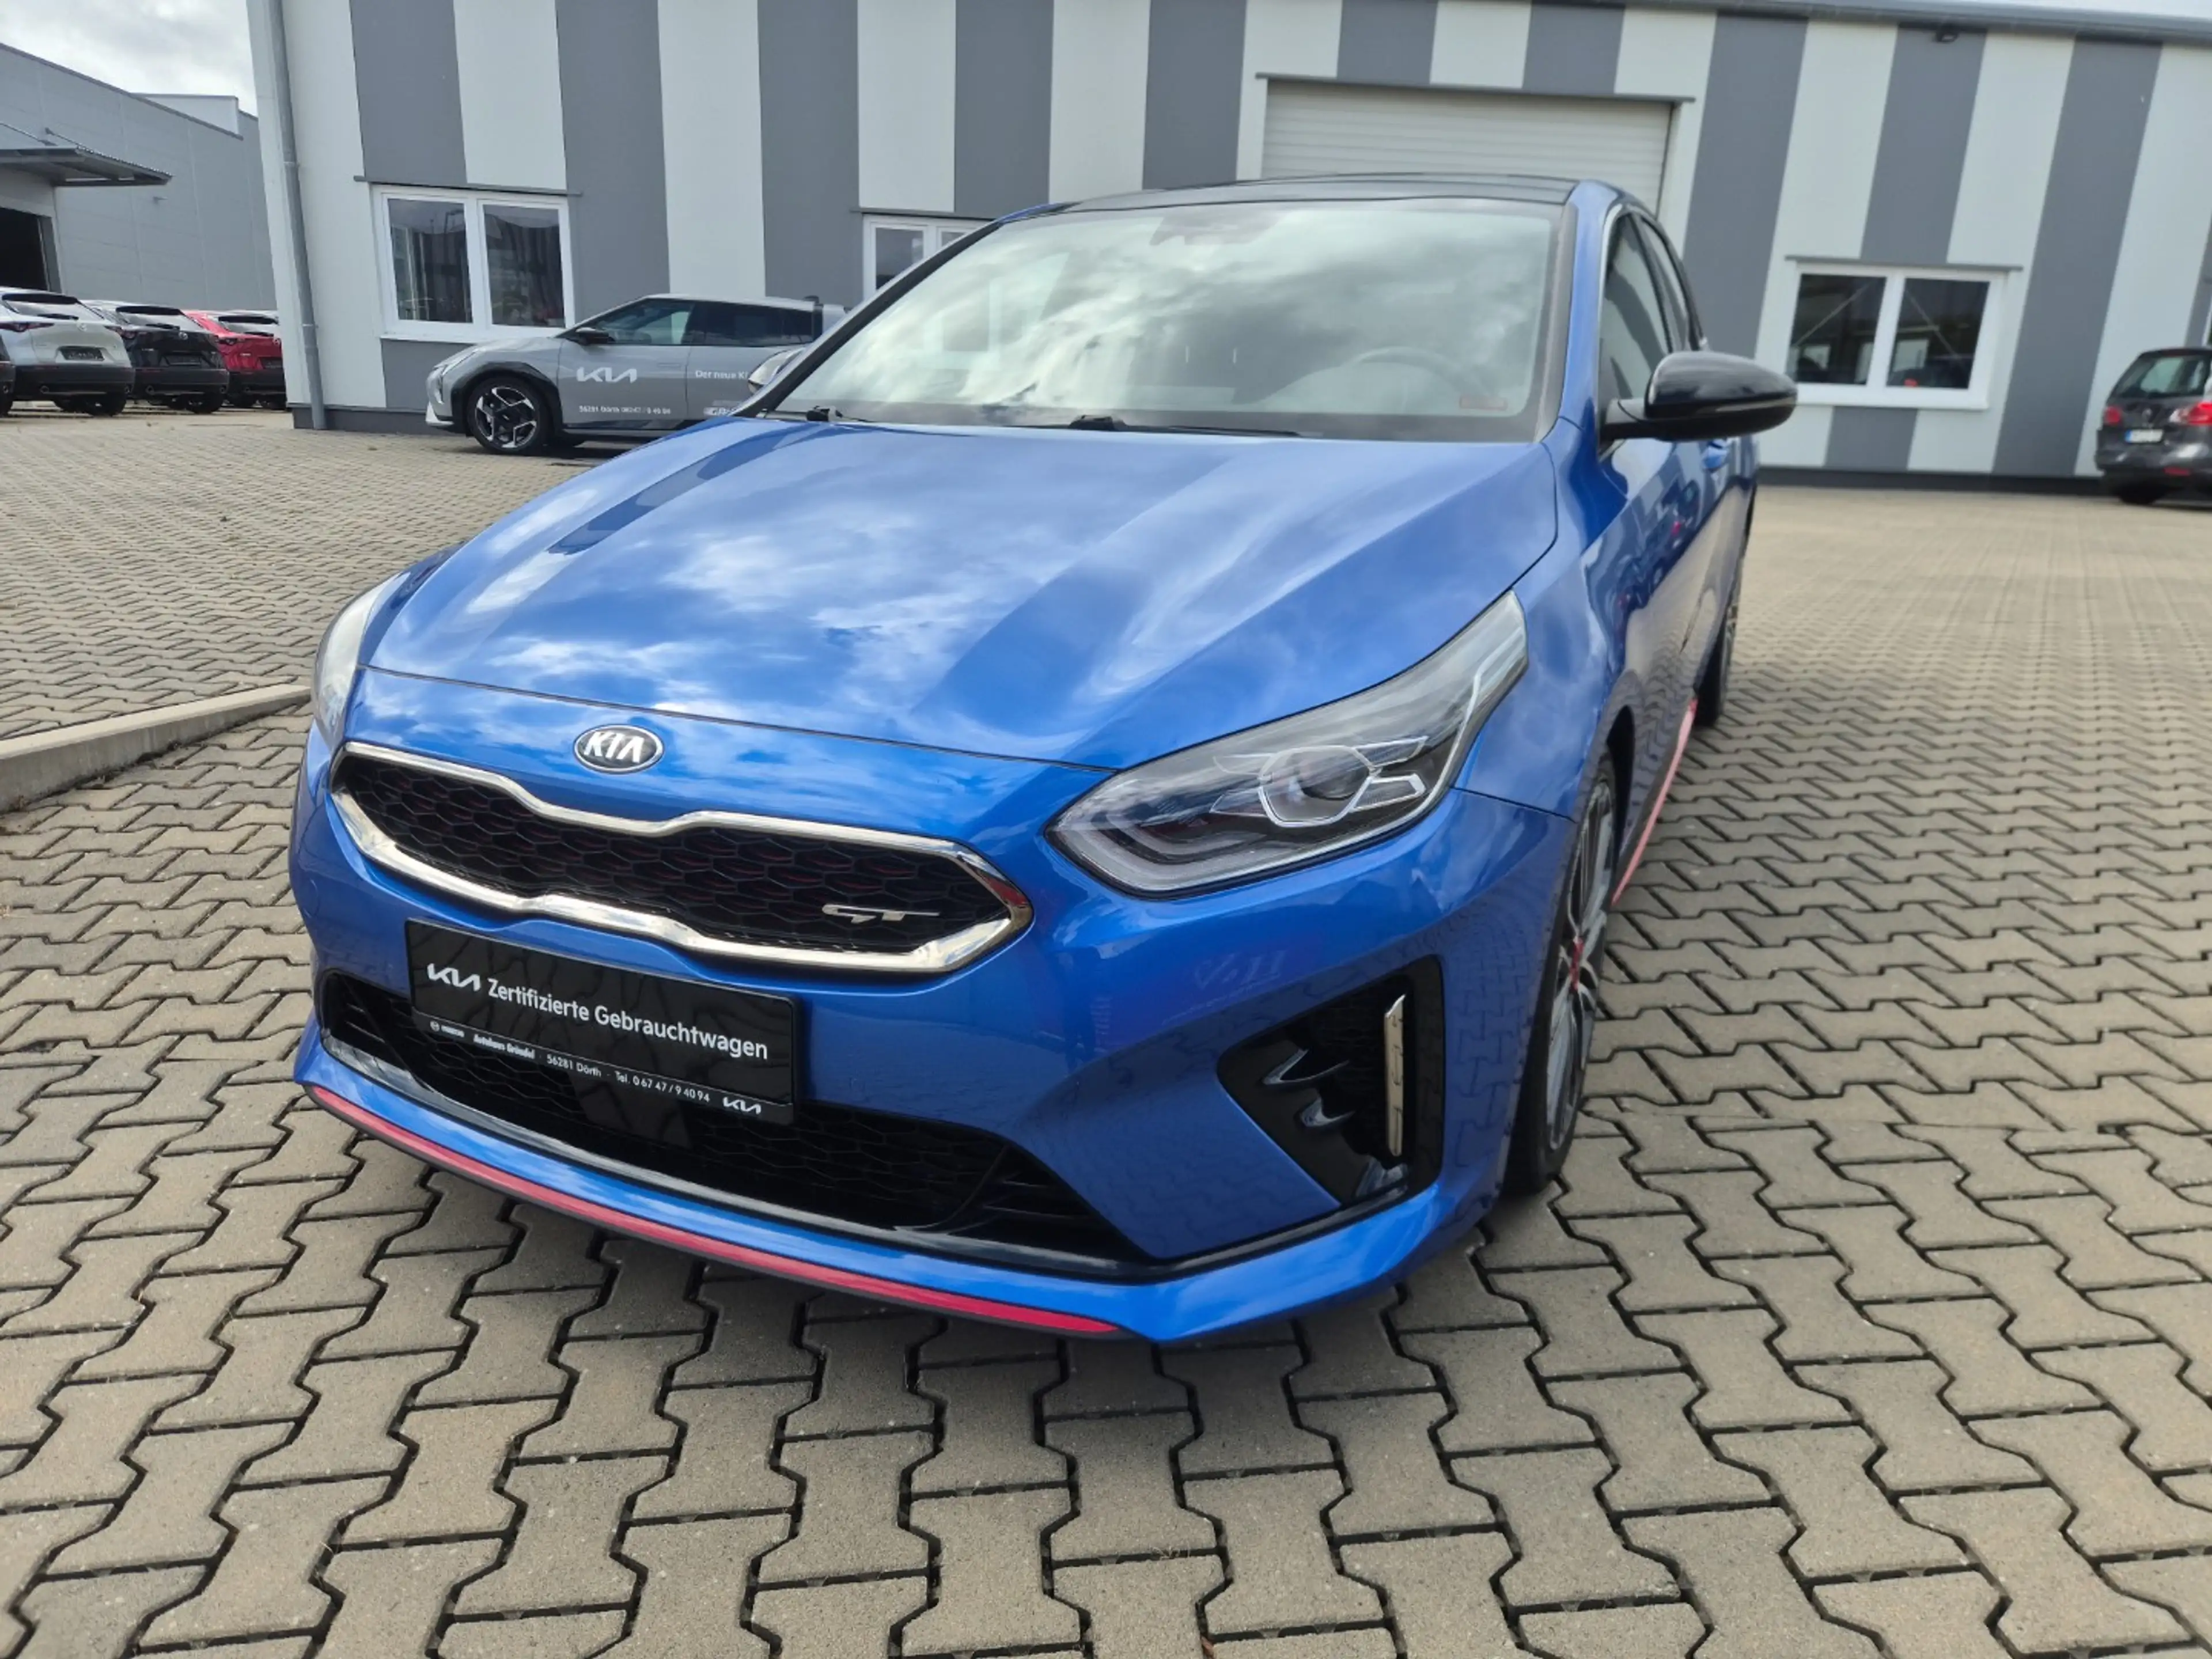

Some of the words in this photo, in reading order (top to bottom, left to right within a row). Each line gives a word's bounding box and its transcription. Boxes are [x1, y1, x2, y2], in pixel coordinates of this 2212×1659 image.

[577, 366, 637, 384] KIA
[584, 730, 645, 763] KIA
[822, 904, 940, 924] GT
[427, 963, 481, 992] KIA
[487, 978, 589, 1021] Zertifizierte
[594, 1005, 768, 1060] Gebrauchtwagen
[547, 1054, 574, 1070] 56281
[576, 1062, 601, 1078] Dörth
[614, 1070, 630, 1084] Tel.
[723, 1097, 761, 1115] KIA
